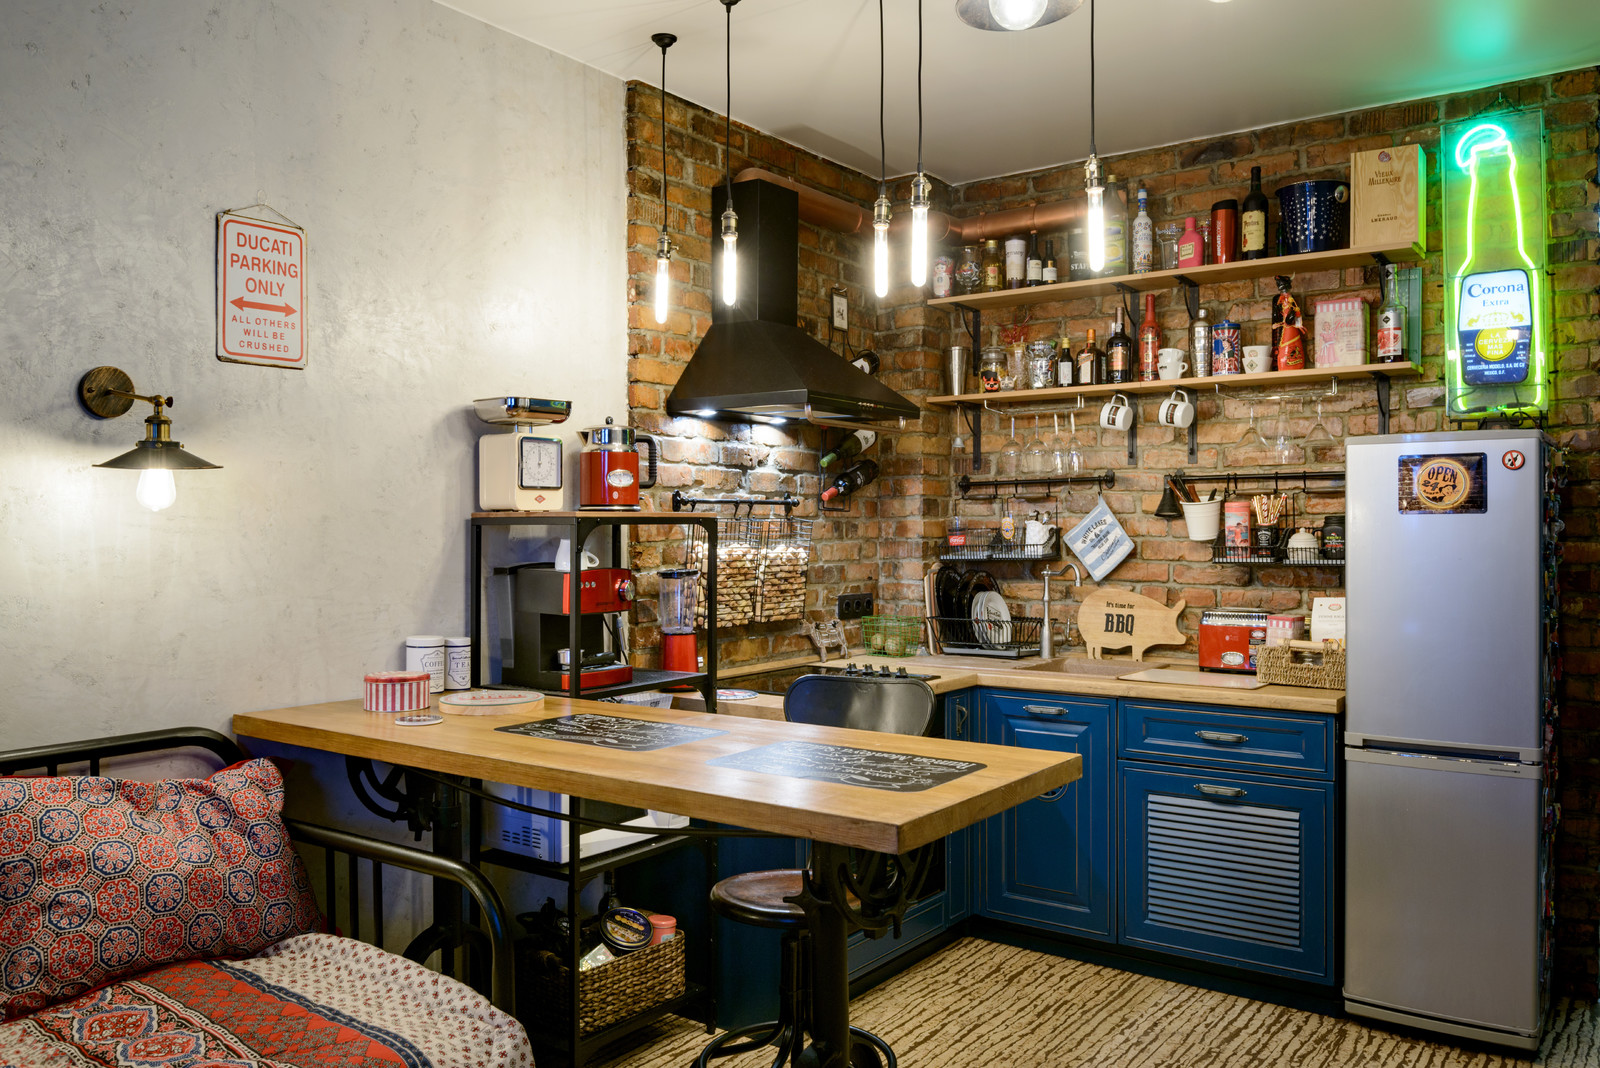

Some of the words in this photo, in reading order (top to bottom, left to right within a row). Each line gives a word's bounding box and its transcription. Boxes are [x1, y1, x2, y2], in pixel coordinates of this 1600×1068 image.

[236, 232, 293, 257] DUCATI
[230, 253, 299, 279] PARKING
[245, 277, 285, 297] ONLY
[1467, 282, 1524, 298] Corona
[1482, 299, 1509, 307] Extra
[231, 315, 251, 325] ALL
[254, 317, 296, 330] OTHERS
[243, 328, 269, 339] WILL
[272, 331, 285, 341] BE
[1478, 337, 1514, 345] CERVEZA
[238, 340, 289, 353] CRUSHED
[1427, 465, 1458, 484] OPEN
[1421, 479, 1440, 491] 24
[1103, 612, 1135, 637] BBQ
